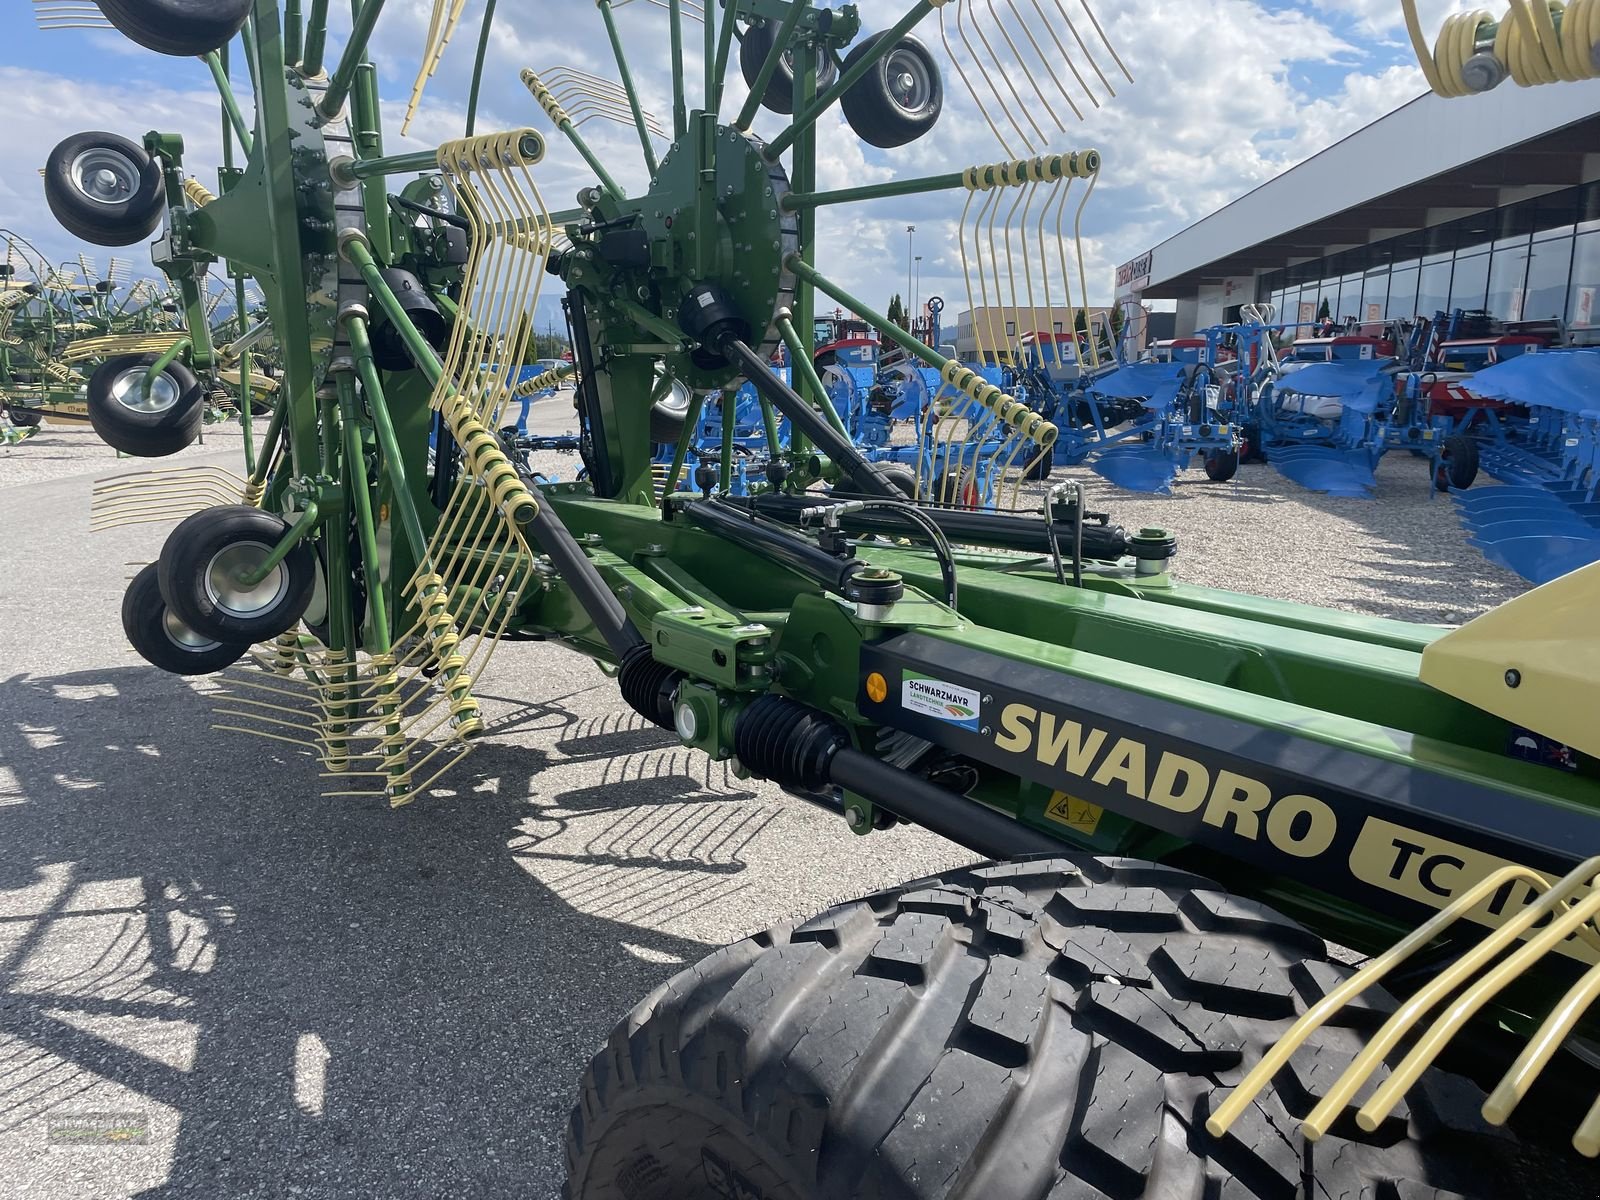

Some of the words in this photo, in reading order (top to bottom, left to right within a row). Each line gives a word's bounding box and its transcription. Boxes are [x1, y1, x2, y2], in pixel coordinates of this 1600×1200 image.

[909, 680, 969, 707] SCHWARZMAYR
[910, 691, 944, 707] LANDTECHNIK
[994, 702, 1338, 859] SWADRO
[1389, 838, 1465, 897] TC
